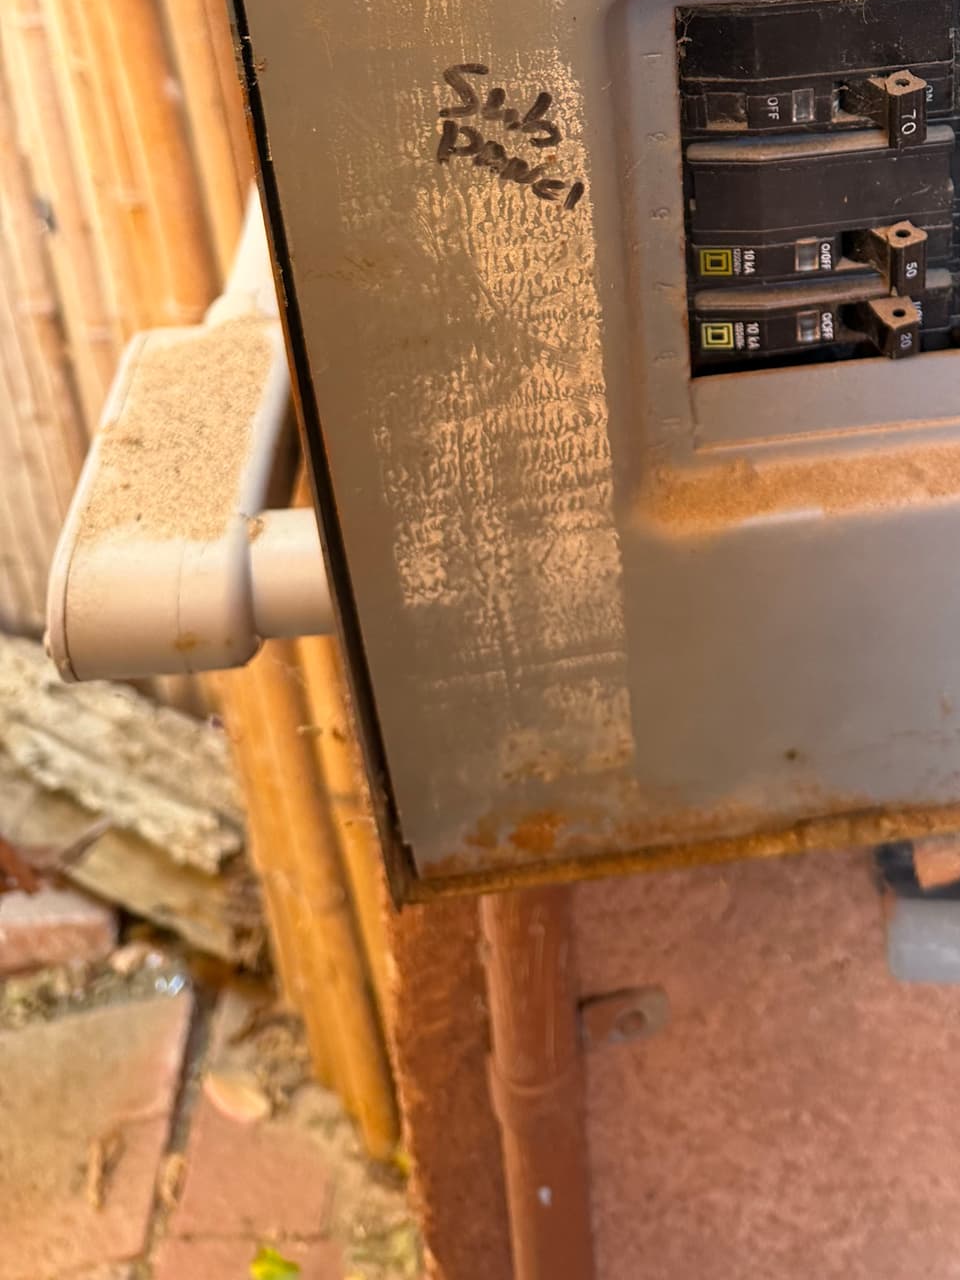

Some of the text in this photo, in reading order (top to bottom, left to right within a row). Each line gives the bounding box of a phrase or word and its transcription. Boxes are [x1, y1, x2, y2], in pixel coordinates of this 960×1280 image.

[767, 96, 779, 120] OFF
[901, 108, 917, 135] 70
[905, 261, 918, 278] 50
[900, 332, 913, 348] 20
